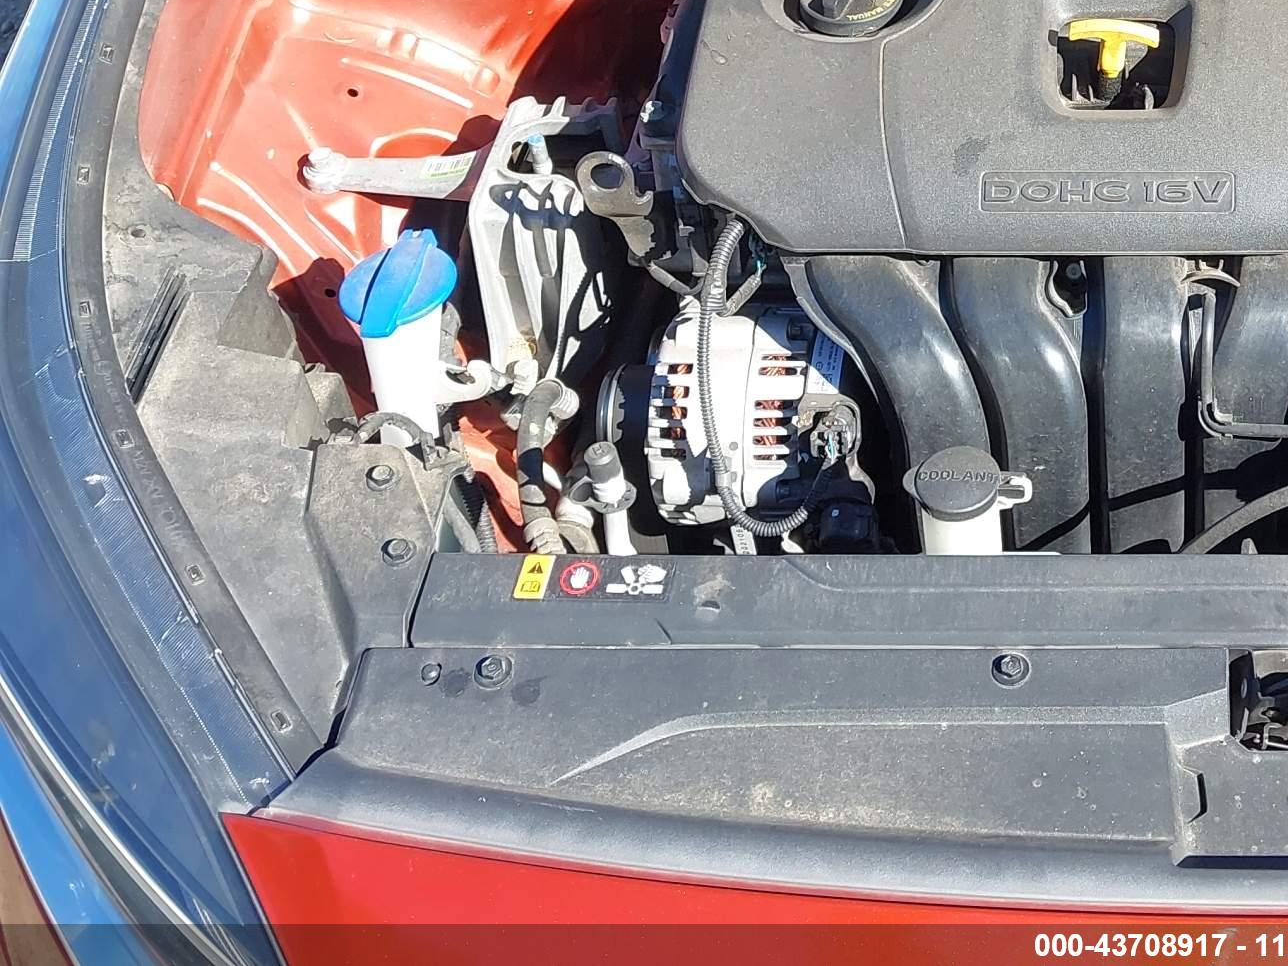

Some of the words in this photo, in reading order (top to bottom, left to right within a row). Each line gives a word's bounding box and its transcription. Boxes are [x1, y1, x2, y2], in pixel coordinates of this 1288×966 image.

[846, 6, 884, 21] MANUAL
[983, 179, 1131, 205] DOHC
[1143, 178, 1231, 205] 16V
[917, 468, 1000, 483] COOLANT
